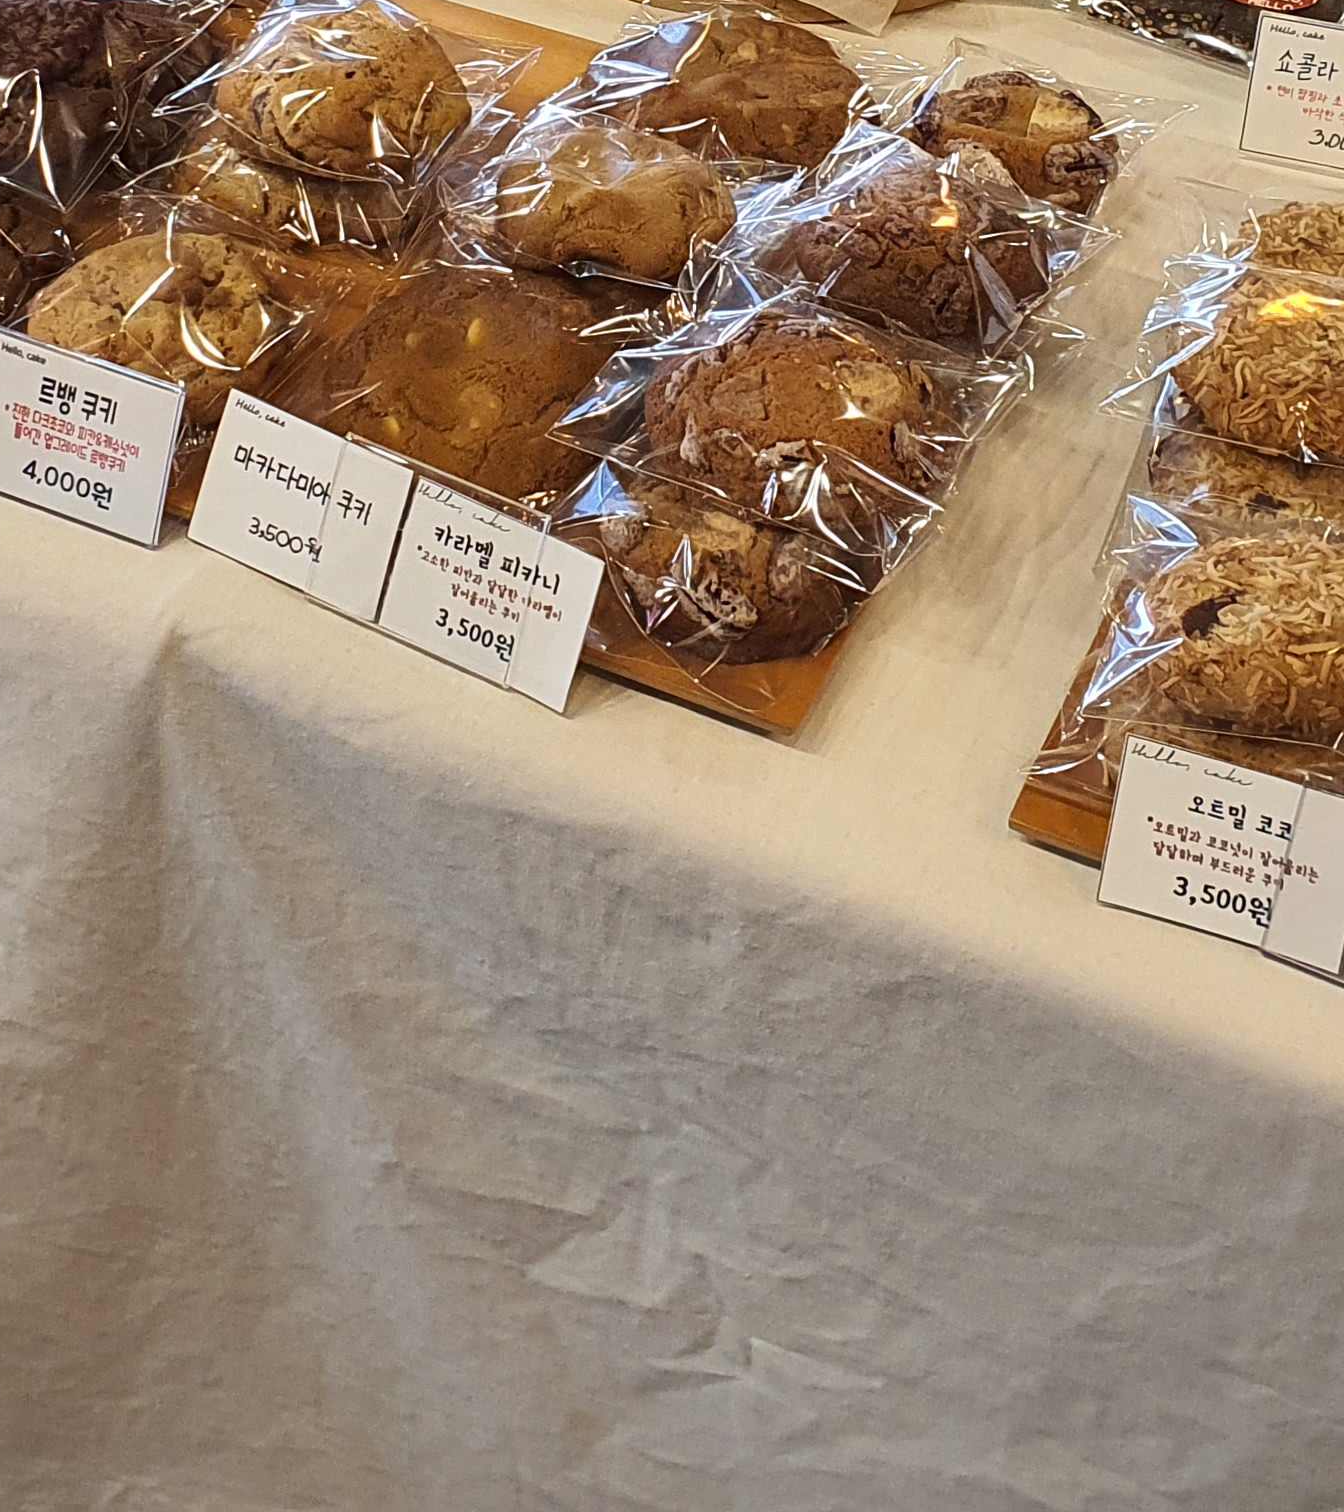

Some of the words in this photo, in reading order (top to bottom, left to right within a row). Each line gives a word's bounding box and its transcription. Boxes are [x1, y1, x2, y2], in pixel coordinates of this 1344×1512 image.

[1274, 49, 1338, 81] 쇼콜라
[1, 343, 25, 359] Hello,
[26, 352, 47, 365] cake
[39, 376, 77, 416] 르뱅
[81, 391, 118, 425] 쿠키
[235, 399, 262, 419] Hello,
[265, 413, 286, 428] cake
[22, 460, 114, 511] 4,000원
[234, 445, 331, 506] 마카다미아
[337, 489, 372, 526] 쿠키
[248, 517, 323, 563] 3,500원
[421, 550, 450, 572] 고소한
[434, 525, 494, 570] 카라멜
[500, 556, 561, 596] 피카니
[435, 608, 515, 663] 3,500원
[1188, 795, 1247, 831] 오트밀
[1256, 814, 1293, 841] 코코
[1152, 840, 1204, 866] 달달하며
[1209, 856, 1255, 884] 부드러운
[1153, 820, 1202, 844] 오트밀과
[1206, 835, 1253, 860] 코코넛이
[1259, 852, 1320, 884] 잘어울리는
[1172, 876, 1273, 929] 3,500원
